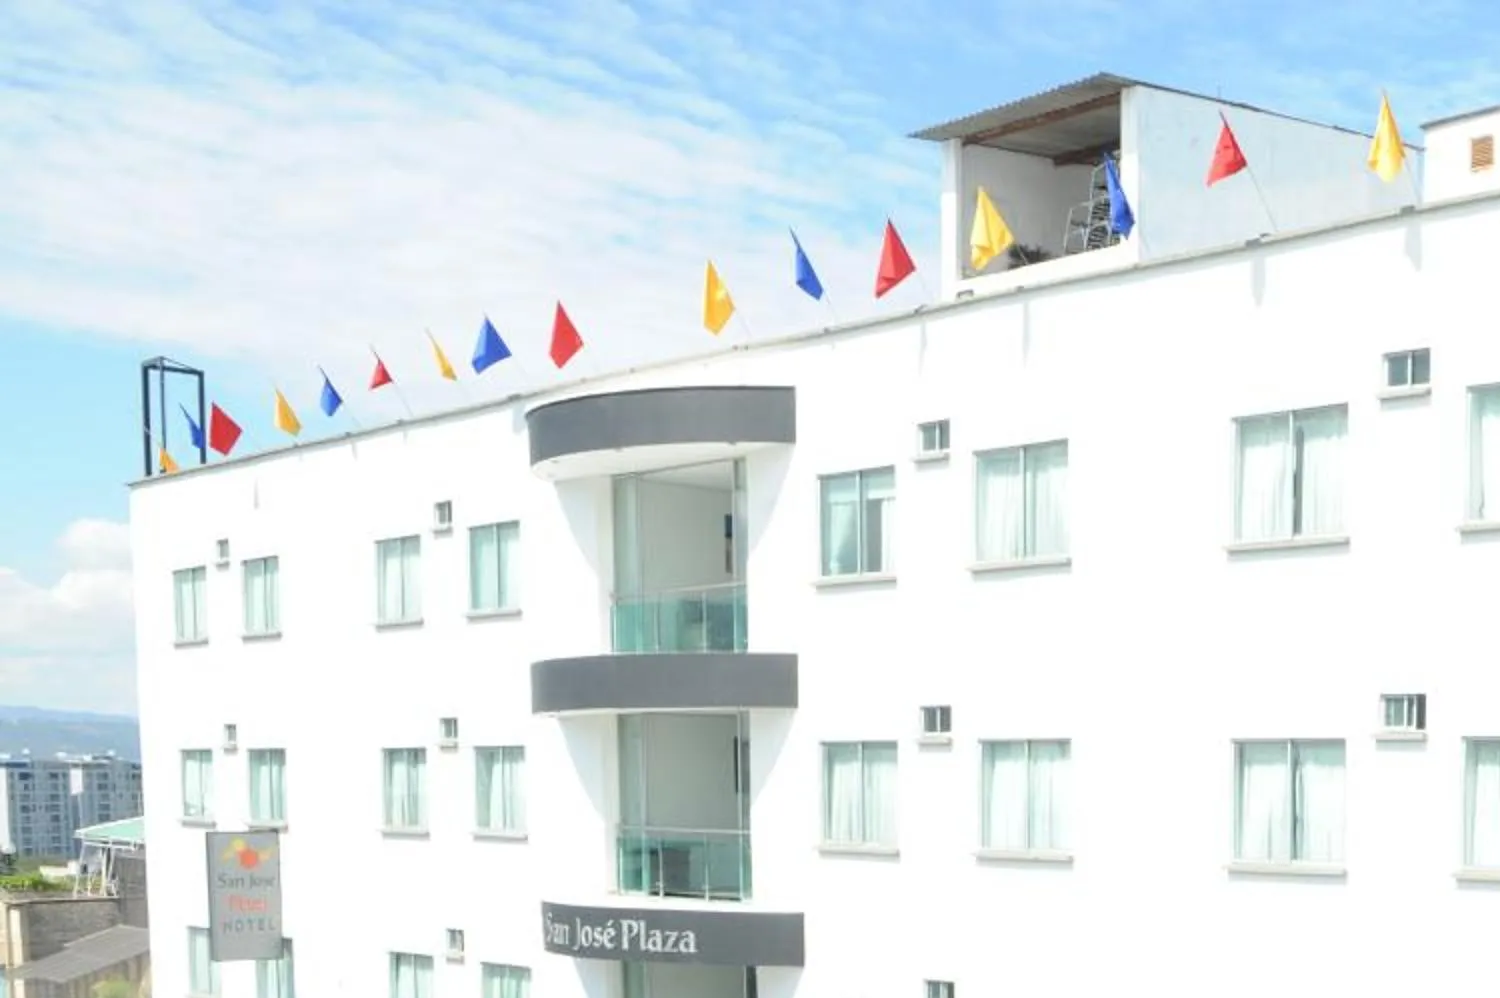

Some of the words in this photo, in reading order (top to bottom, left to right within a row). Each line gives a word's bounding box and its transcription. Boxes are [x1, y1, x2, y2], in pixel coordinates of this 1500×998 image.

[216, 873, 245, 889] San
[222, 917, 277, 934] HOTEL
[572, 917, 617, 951] José
[620, 919, 699, 953] Plaza
